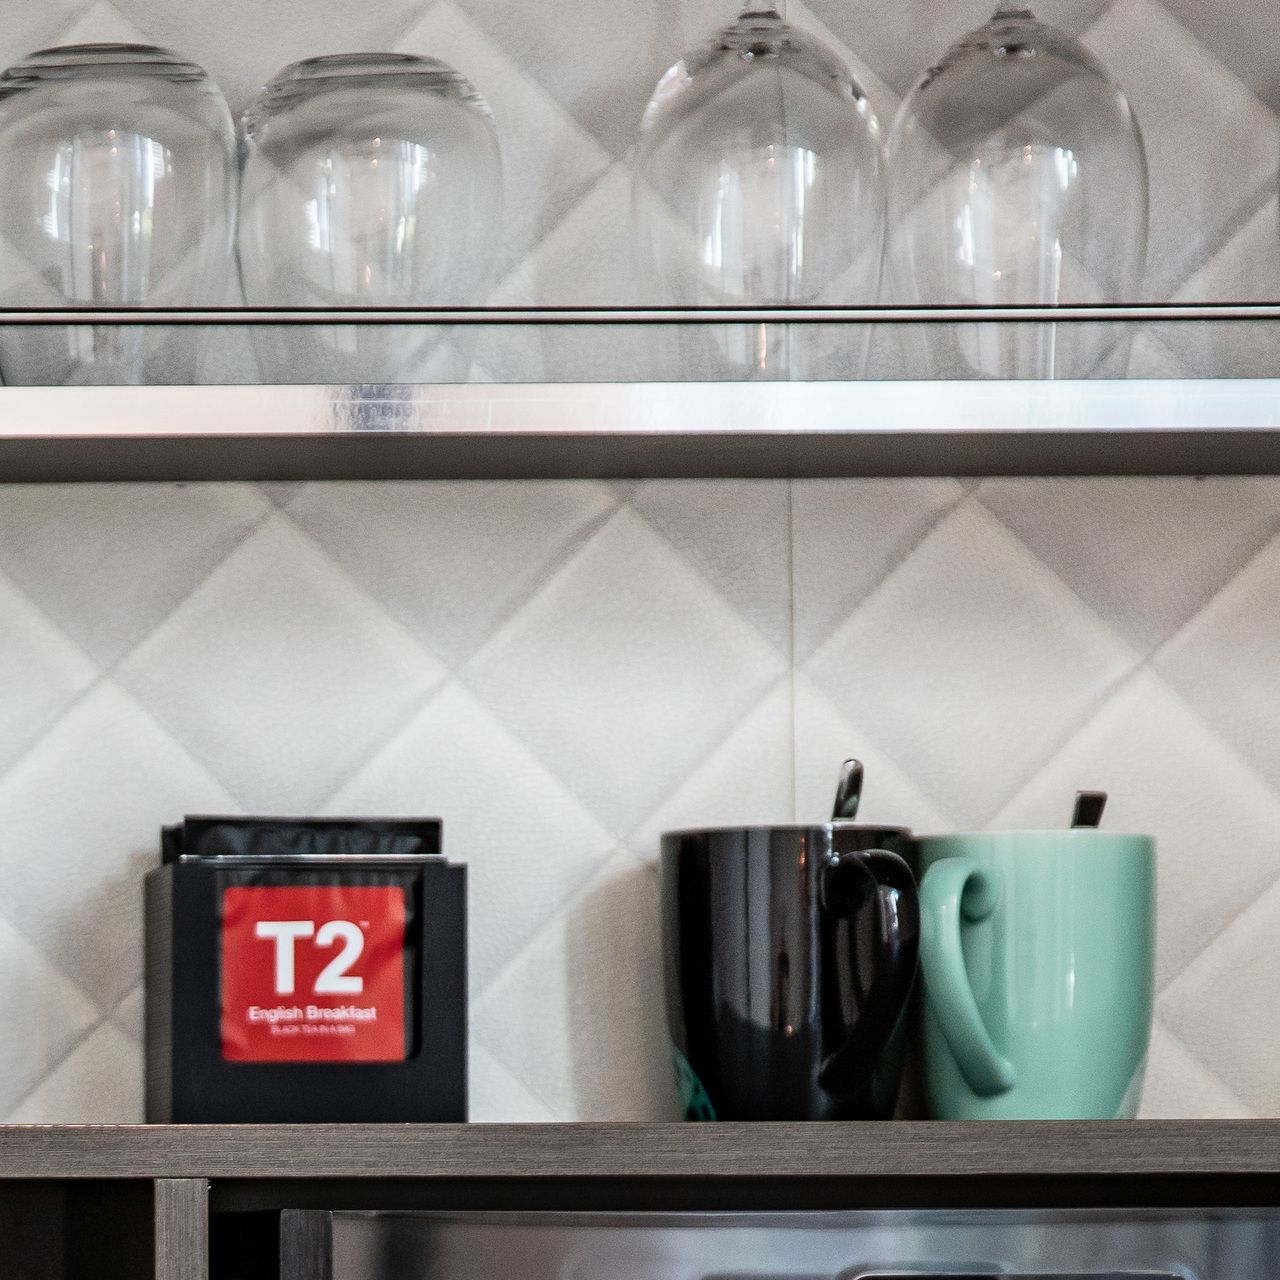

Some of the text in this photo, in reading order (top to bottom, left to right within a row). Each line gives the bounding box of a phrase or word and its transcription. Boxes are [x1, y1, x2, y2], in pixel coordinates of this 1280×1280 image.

[255, 920, 365, 994] T2
[248, 1005, 376, 1023] English Breakfast
